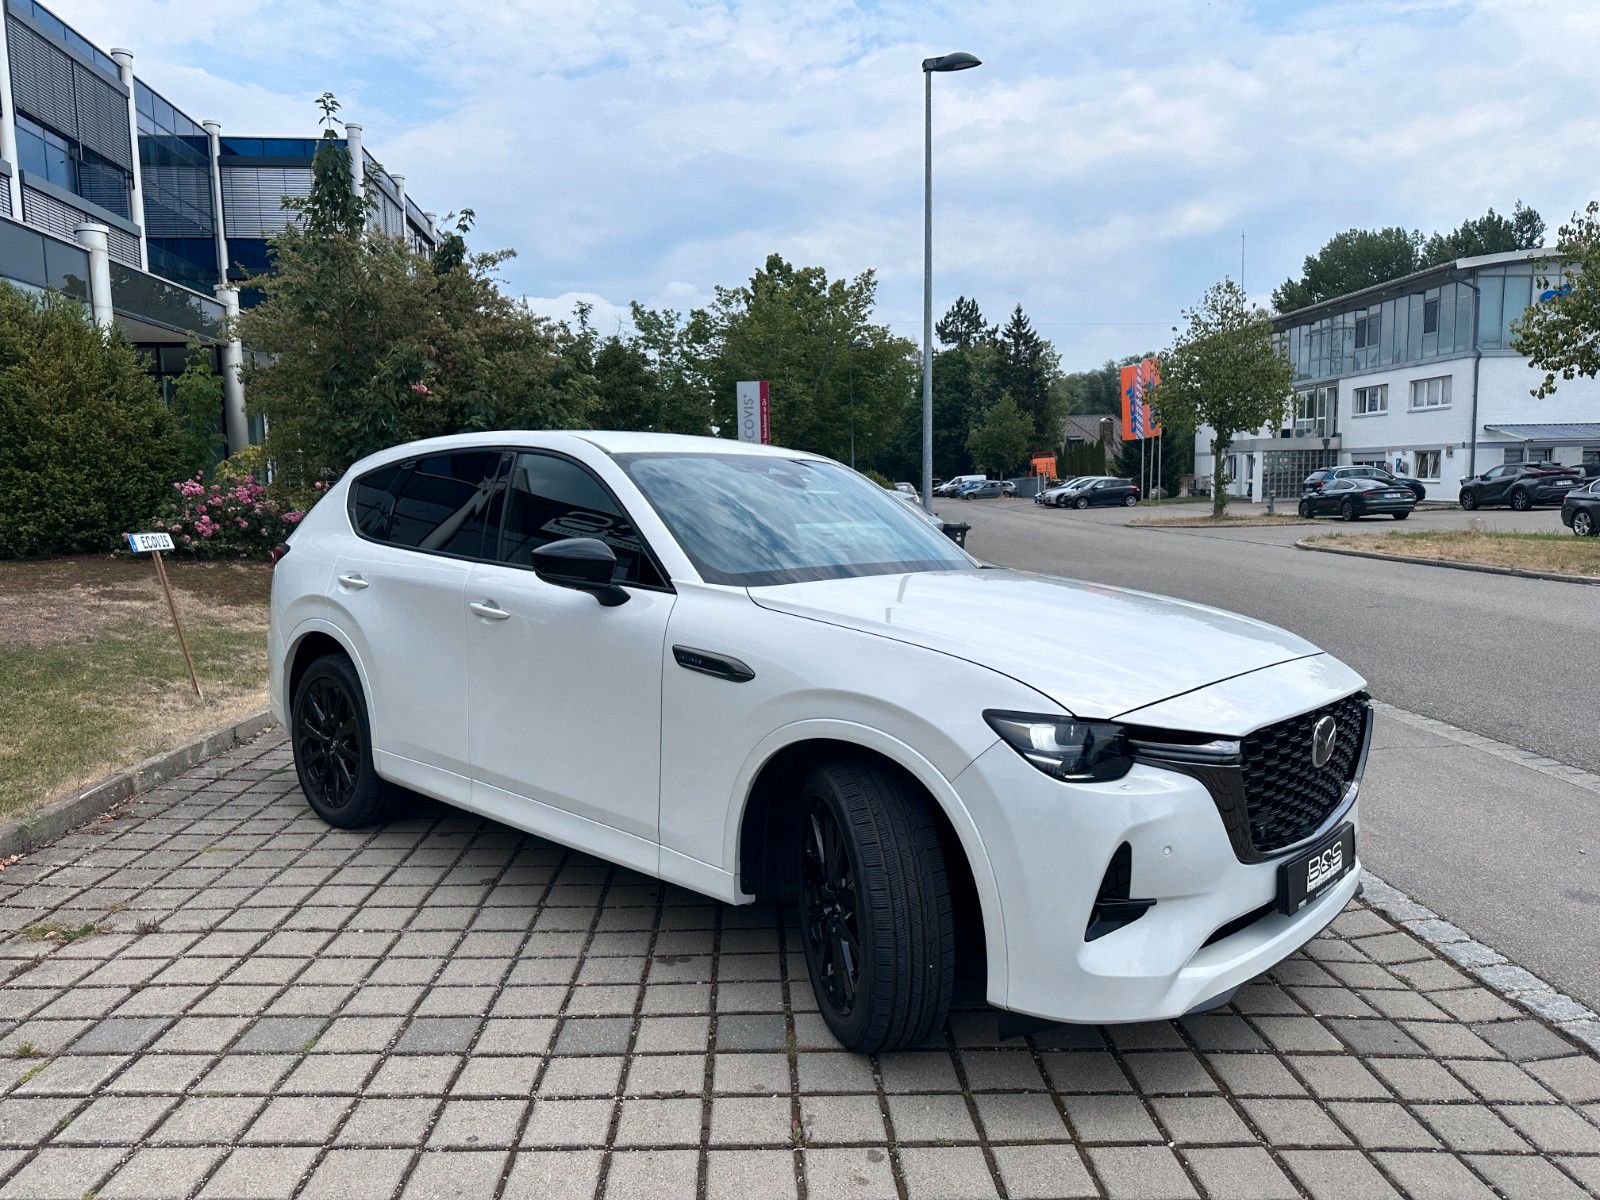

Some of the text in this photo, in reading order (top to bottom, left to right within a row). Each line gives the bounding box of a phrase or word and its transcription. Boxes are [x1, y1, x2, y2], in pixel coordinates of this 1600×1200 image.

[743, 398, 755, 442] COVIS
[140, 534, 170, 549] ECOVIS
[1308, 841, 1342, 882] B&S
